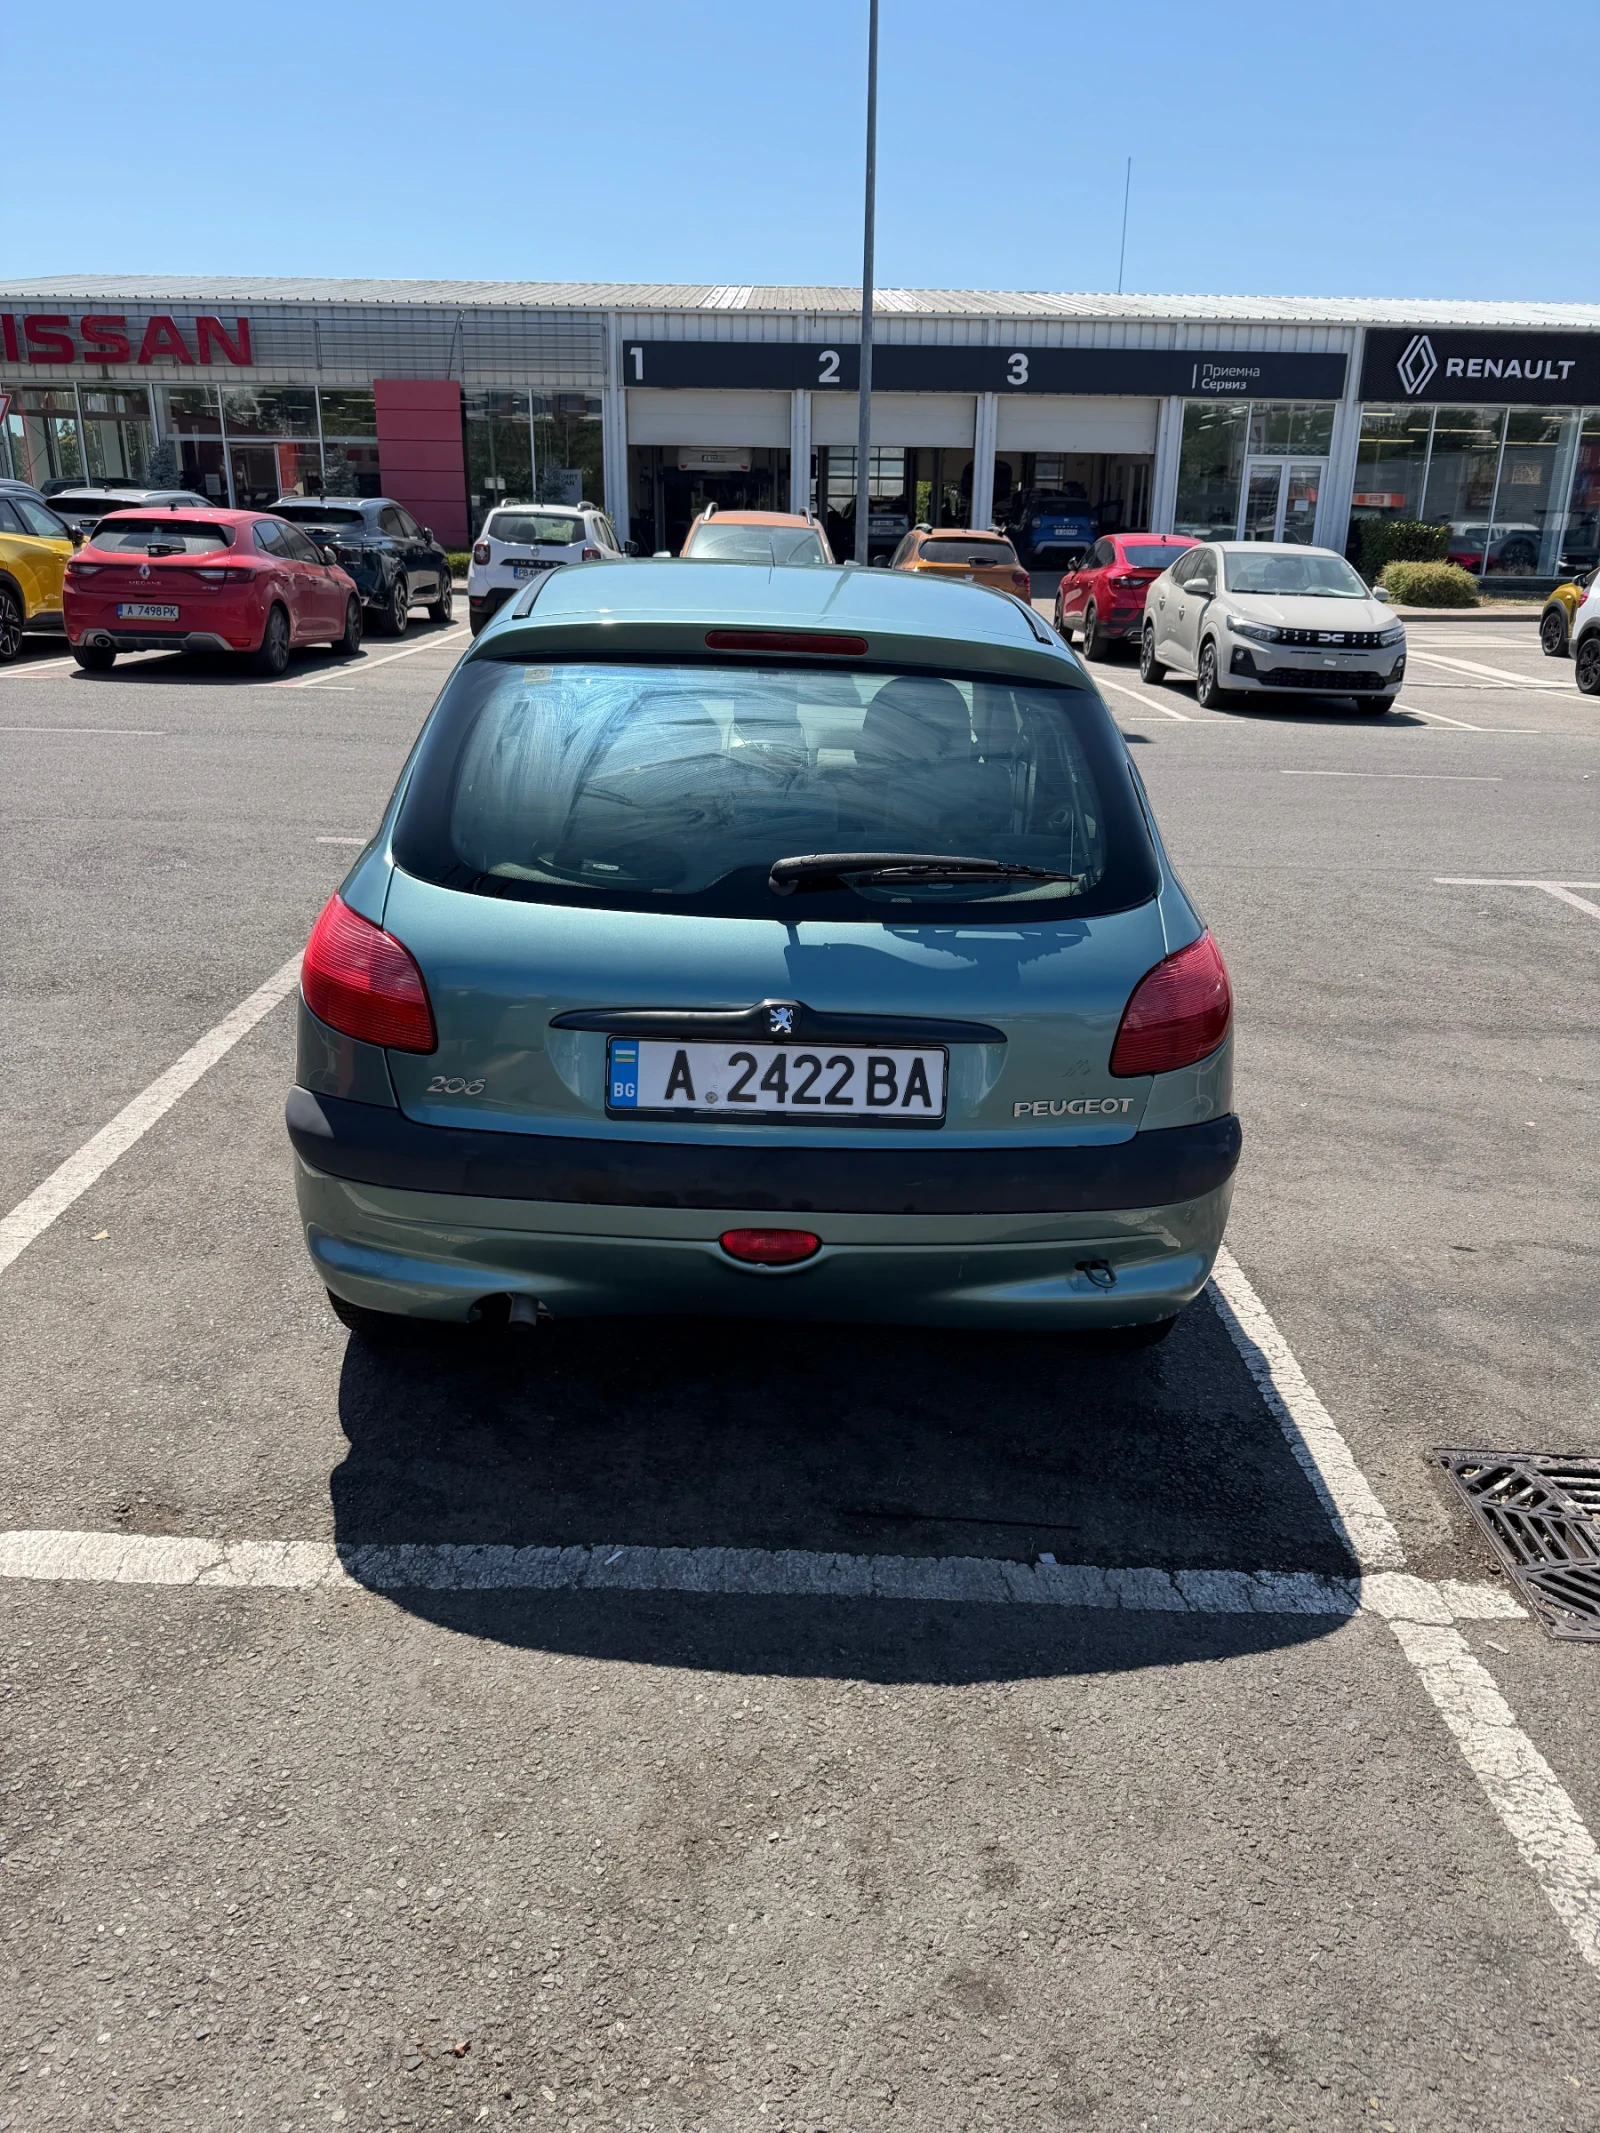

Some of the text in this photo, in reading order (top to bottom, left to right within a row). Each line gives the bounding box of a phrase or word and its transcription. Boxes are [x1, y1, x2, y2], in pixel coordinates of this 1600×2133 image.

[1, 313, 253, 365] ISSAN
[629, 347, 645, 380] 1
[818, 350, 841, 383] 2
[1006, 353, 1030, 385] 3
[1202, 363, 1261, 380] Приемна
[1446, 357, 1576, 380] RENAULT
[1201, 378, 1247, 393] Сервиз
[426, 1075, 486, 1096] 206
[664, 1050, 696, 1101] A
[613, 1082, 635, 1098] BG
[1013, 1098, 1134, 1118] PEUGEOT
